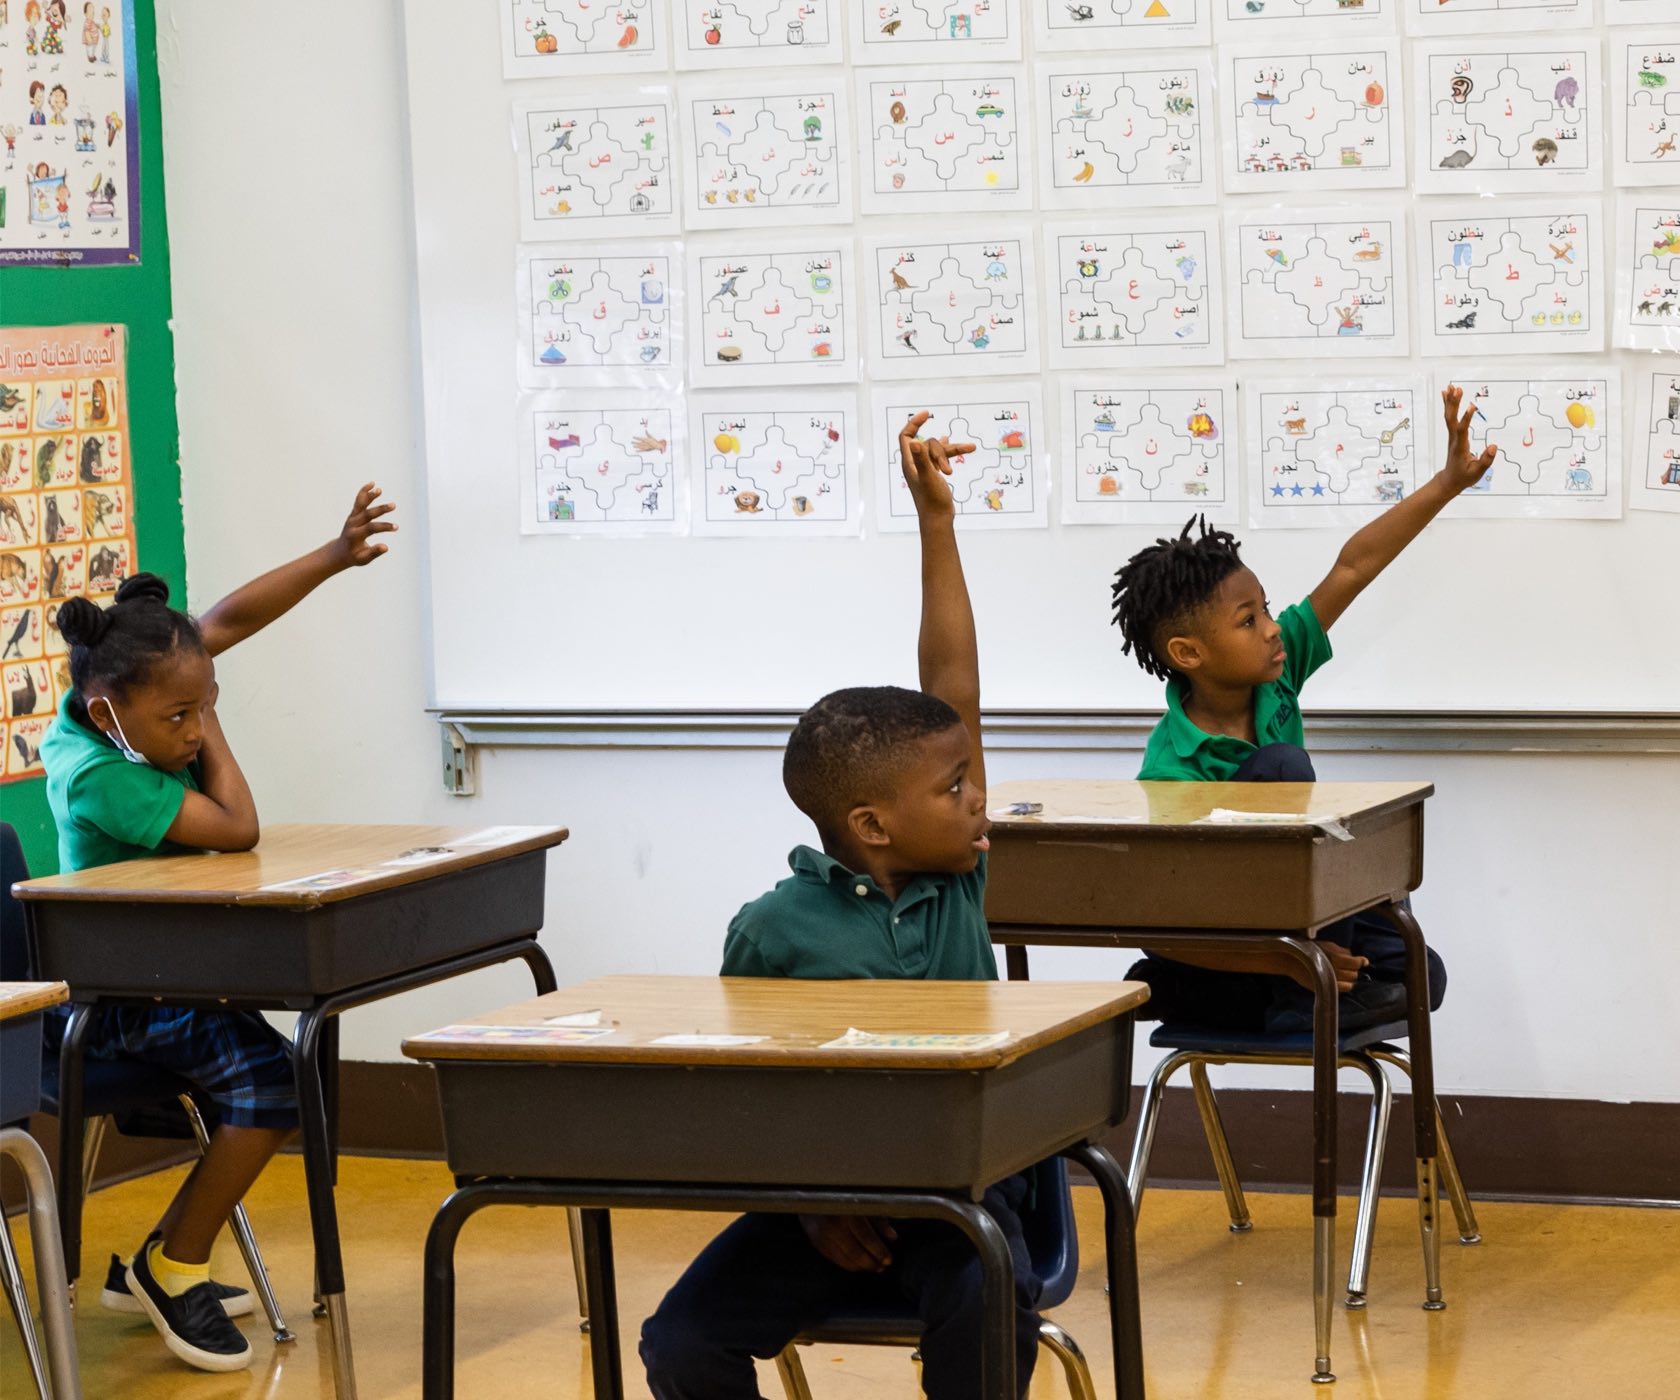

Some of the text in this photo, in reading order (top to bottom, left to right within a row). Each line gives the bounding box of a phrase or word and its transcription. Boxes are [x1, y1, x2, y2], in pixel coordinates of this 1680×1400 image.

[616, 8, 639, 24] بطيخ
[702, 8, 722, 24] تفاح
[798, 4, 815, 19] ملح
[525, 17, 547, 32] خوخ
[1643, 52, 1675, 69] ضفدع
[1348, 62, 1372, 75] رمان
[1159, 77, 1188, 90] زيتون
[712, 105, 735, 116] مشط
[798, 98, 825, 112] شجرة
[1504, 98, 1512, 116] ذ
[1305, 107, 1315, 120] ر
[544, 118, 578, 132] عصفور
[634, 116, 655, 127] صبر
[1123, 118, 1133, 138] ز
[935, 132, 955, 145] س
[1253, 137, 1270, 148] دور
[762, 148, 775, 162] ش
[1067, 146, 1085, 159] موز
[1168, 142, 1191, 157] ماعز
[589, 154, 611, 168] ص
[977, 151, 1005, 164] شمس
[712, 167, 738, 183] فراش
[801, 163, 823, 176] ريش
[540, 185, 572, 195] صوص
[1349, 227, 1371, 244] ظبي
[1448, 227, 1484, 242] بنطلون
[1080, 240, 1107, 252] ساعة
[1165, 239, 1186, 252] عنب
[548, 264, 573, 277] مقص
[715, 264, 748, 279] عصفور
[805, 258, 831, 273] فنجان
[1505, 264, 1520, 280] ط
[1128, 280, 1140, 300] ع
[1644, 284, 1678, 298] بعوض
[949, 291, 957, 307] غ
[1444, 293, 1479, 308] وطواط
[1553, 292, 1567, 307] بط
[764, 301, 780, 315] ف
[1069, 307, 1099, 323] شموع
[808, 323, 831, 334] هاتف
[1566, 386, 1596, 402] ليمون
[1192, 398, 1206, 411] نار
[1282, 401, 1299, 415] نمر
[1374, 398, 1402, 415] مفتاح
[994, 410, 1018, 421] هاتف
[719, 418, 746, 432] ليمون
[1522, 427, 1533, 448] ل
[1145, 439, 1158, 455] ن
[1336, 444, 1344, 459] م
[598, 460, 609, 476] ي
[771, 460, 782, 474] و
[1086, 461, 1119, 476] حلزون
[718, 485, 737, 495] جرو
[816, 483, 830, 496] دلو
